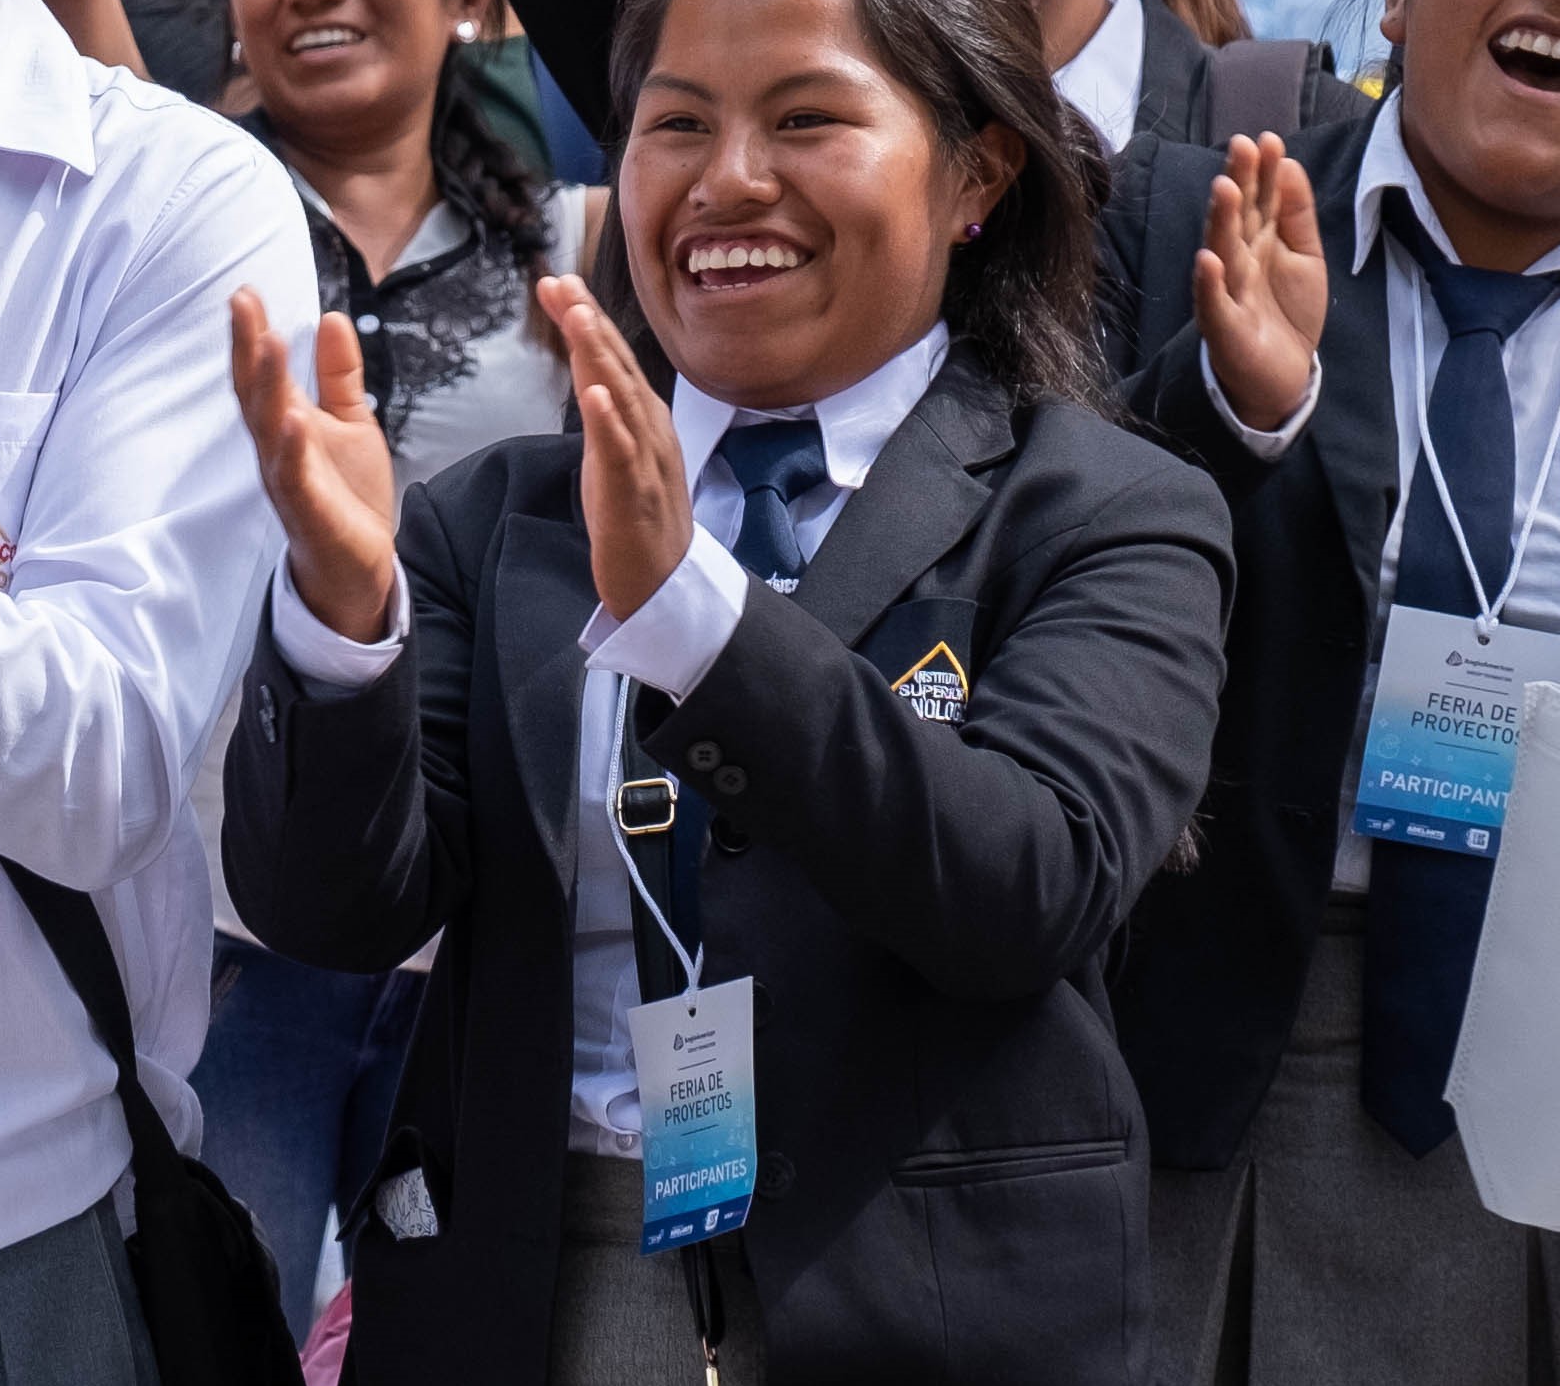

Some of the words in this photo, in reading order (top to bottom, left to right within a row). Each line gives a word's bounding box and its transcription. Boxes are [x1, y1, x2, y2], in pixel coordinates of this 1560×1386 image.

[1427, 693, 1484, 720] FERIA
[1491, 703, 1517, 724] DE
[670, 1075, 705, 1102] FERIA
[708, 1071, 724, 1091] DE
[664, 1091, 732, 1127] PROYECTOS
[655, 1158, 748, 1201] PARTICIPANTES
